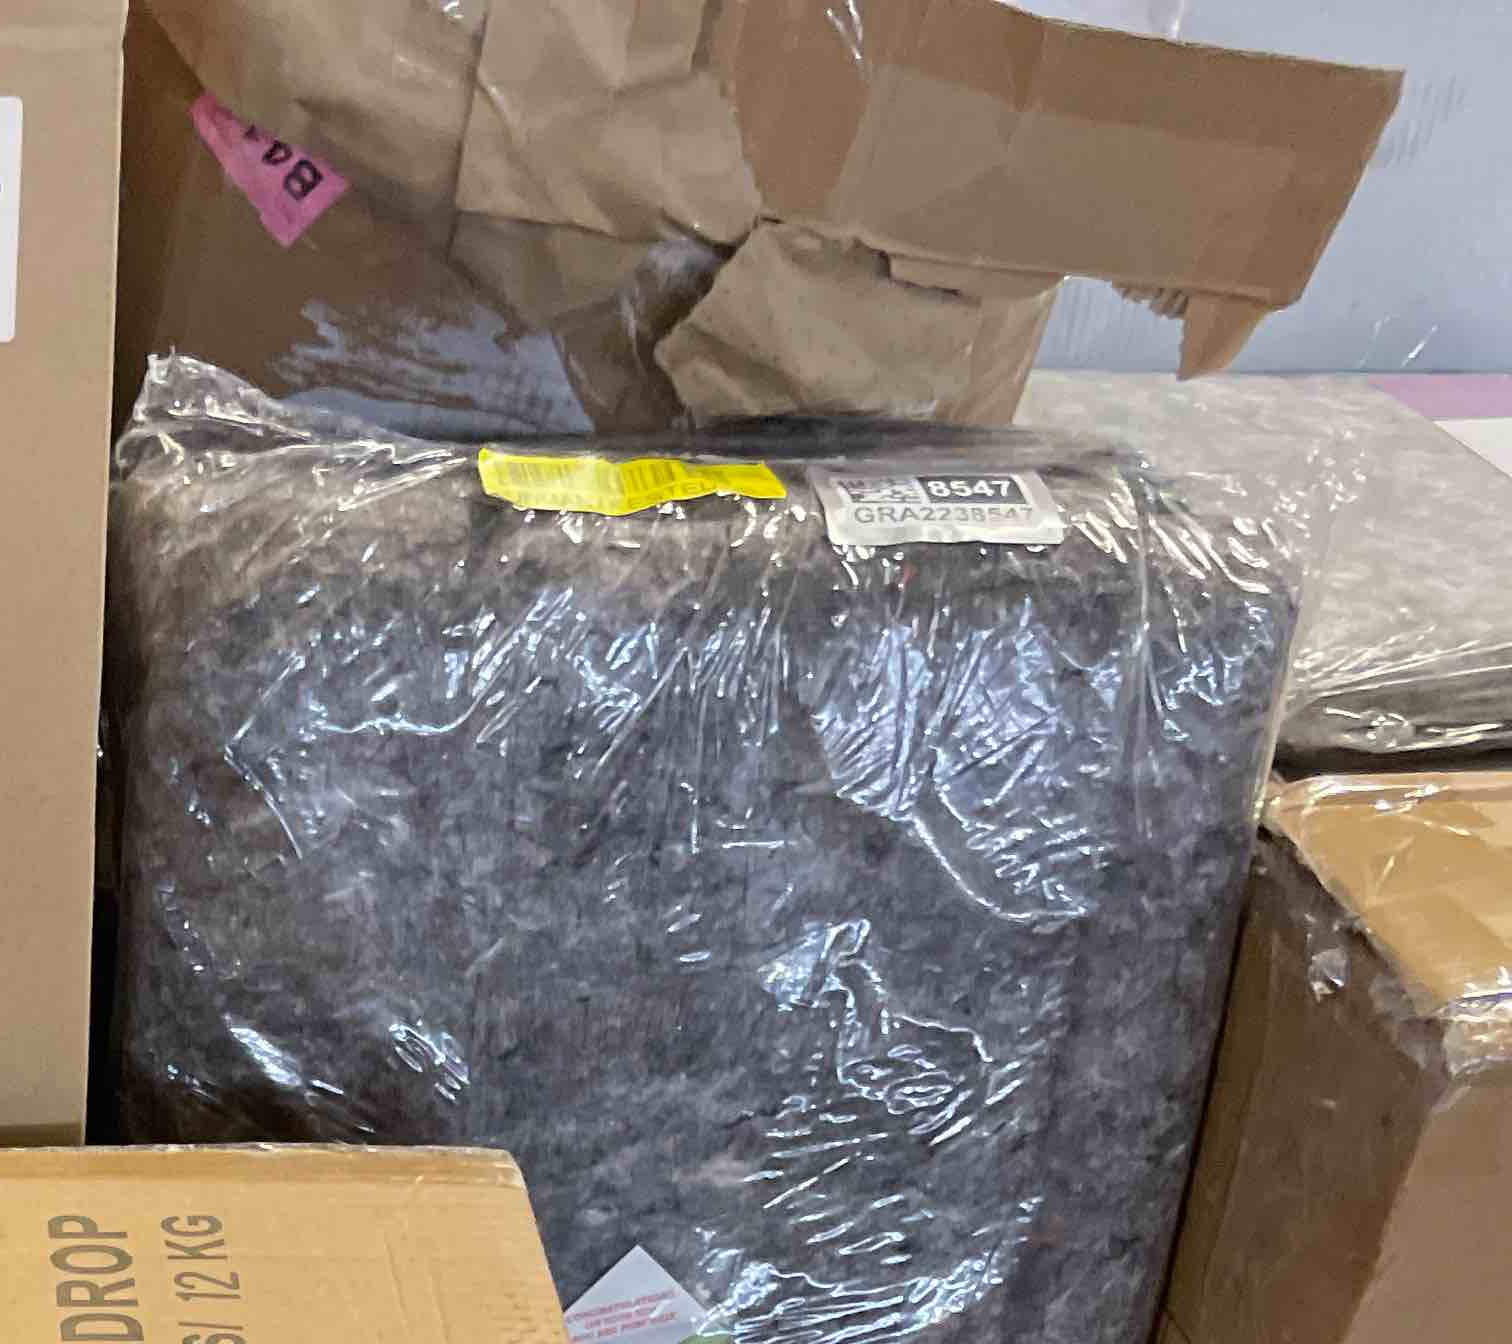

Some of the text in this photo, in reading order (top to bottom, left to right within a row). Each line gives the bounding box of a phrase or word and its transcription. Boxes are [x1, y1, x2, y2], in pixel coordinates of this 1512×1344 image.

[926, 479, 1012, 498] 8547
[160, 1213, 230, 1263] KG
[47, 1213, 146, 1343] DROP
[173, 1269, 242, 1302] 12
